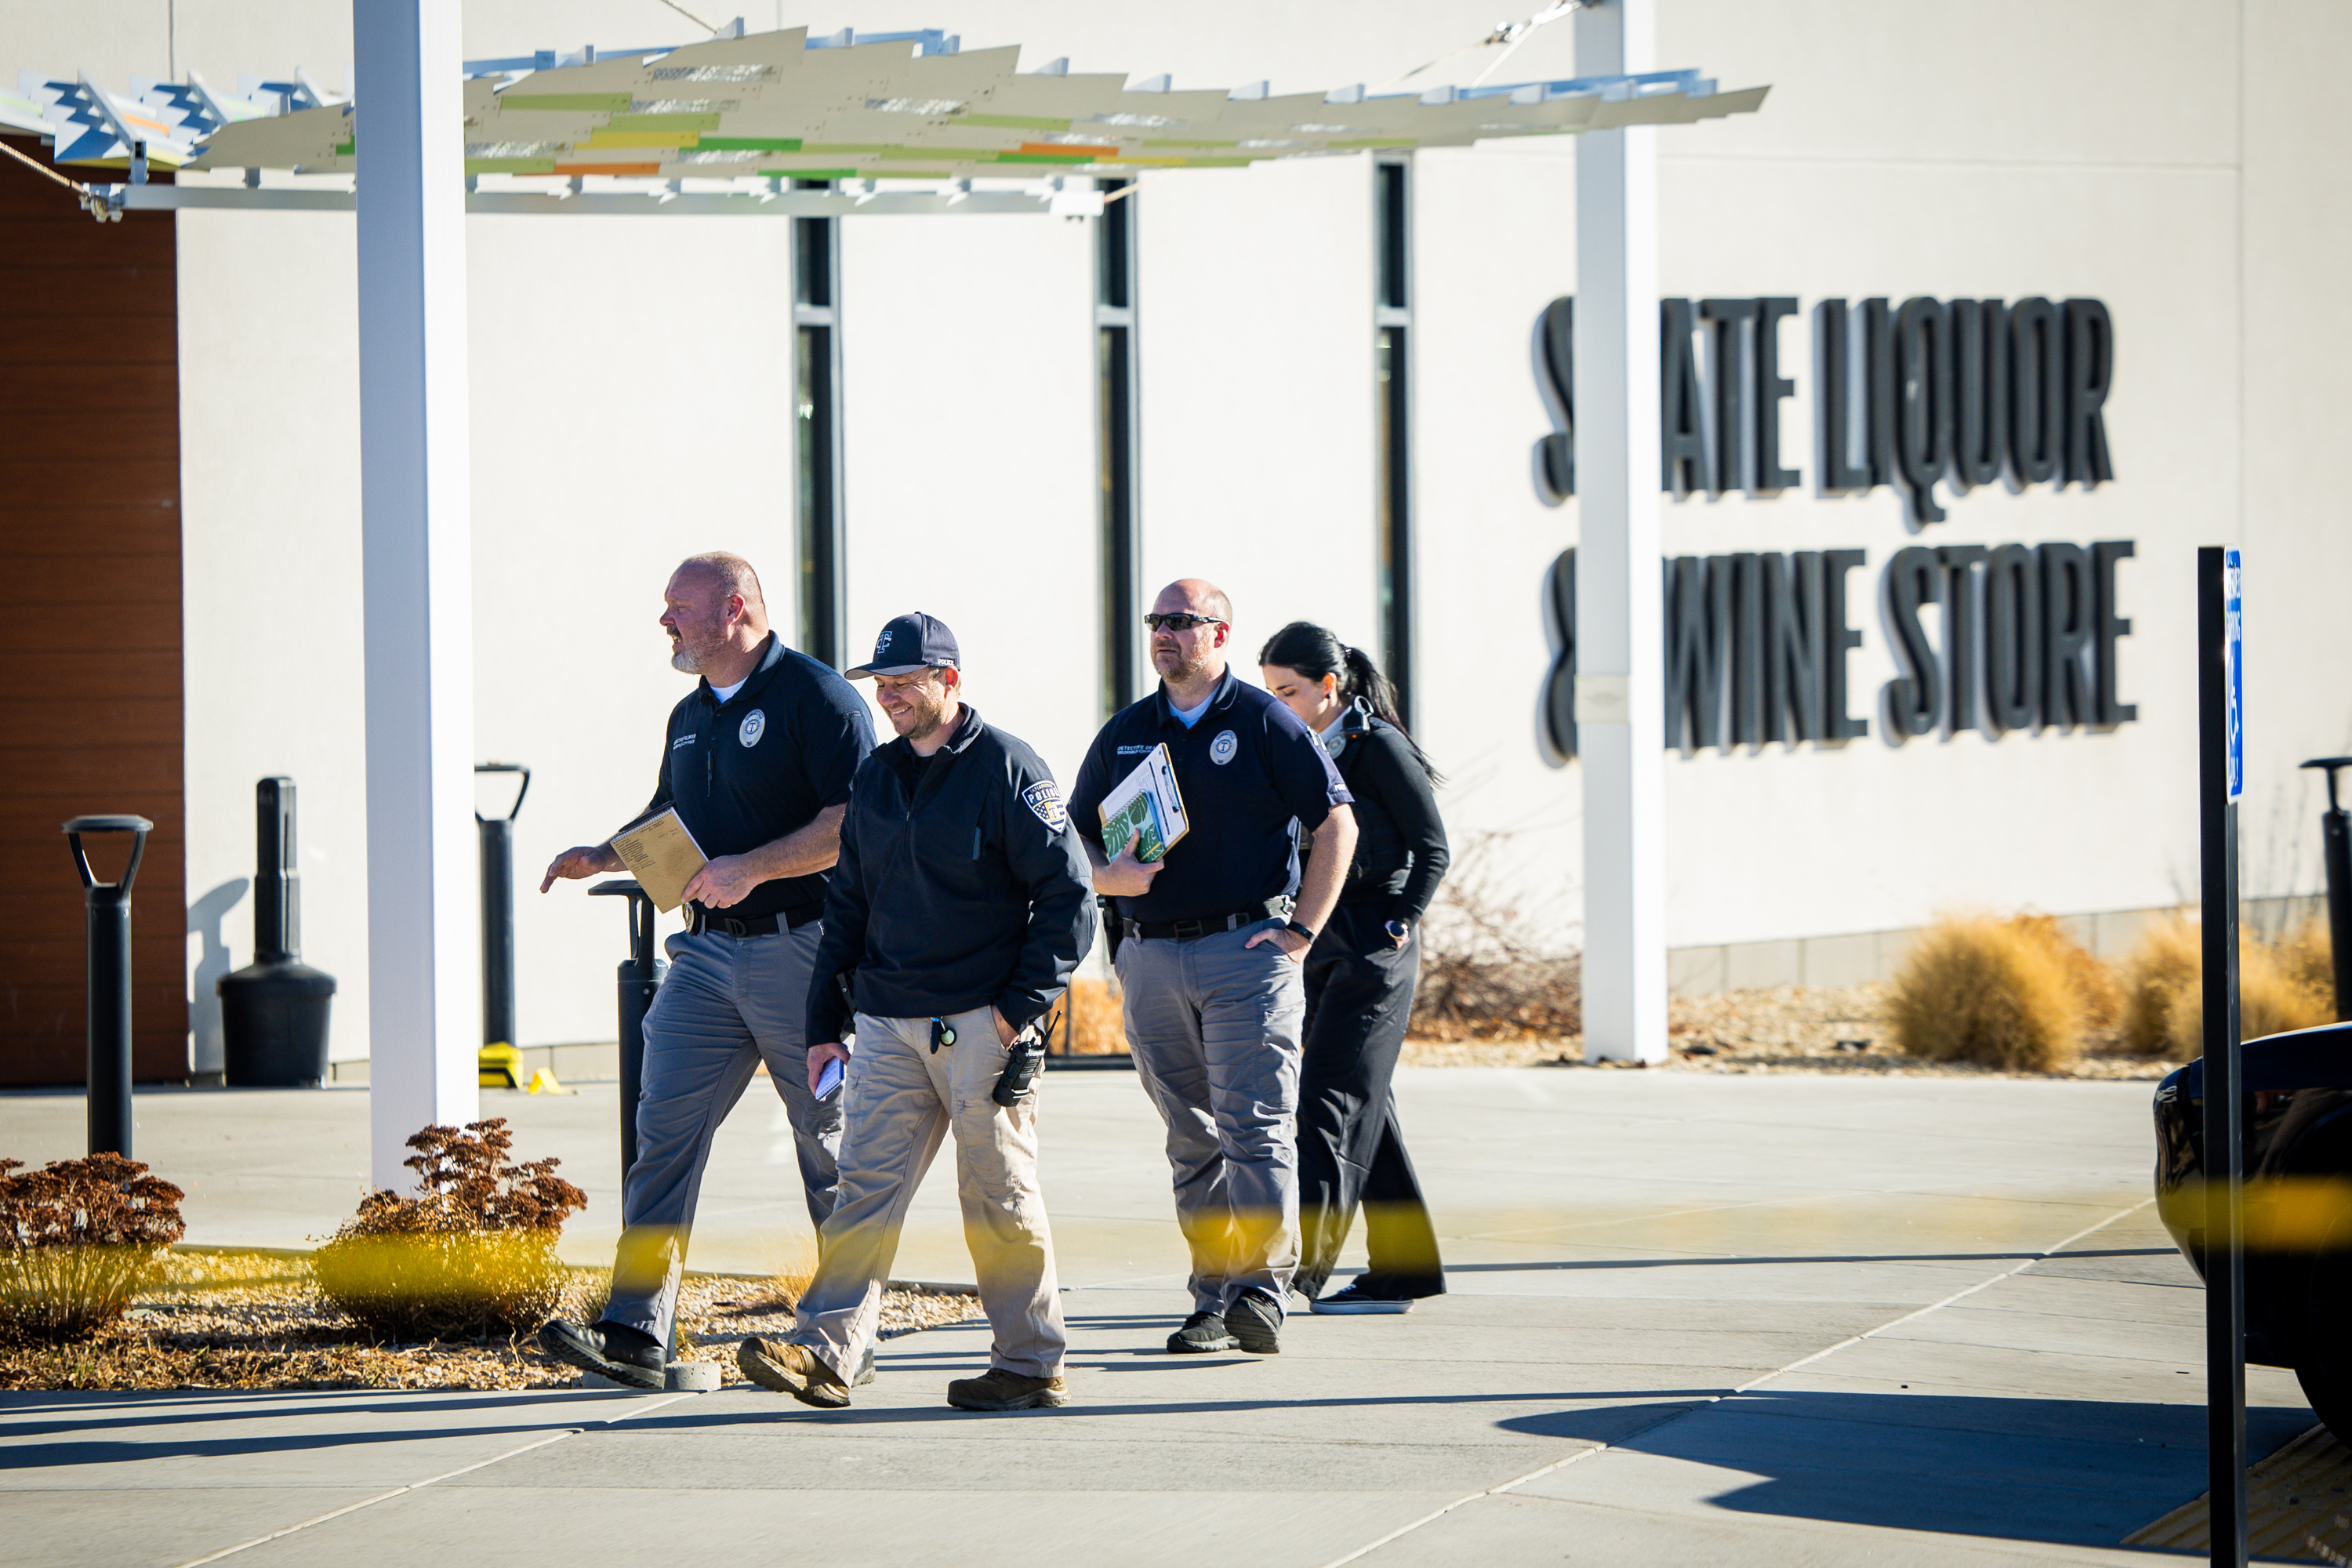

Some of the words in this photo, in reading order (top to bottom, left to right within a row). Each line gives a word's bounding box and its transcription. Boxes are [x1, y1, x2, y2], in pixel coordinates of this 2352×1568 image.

[1531, 296, 1801, 506] SATE
[1813, 297, 2115, 535] LIQUOR
[1663, 549, 1870, 759] WINE
[1877, 540, 2138, 748] STORE
[1027, 787, 1059, 804] POLICE
